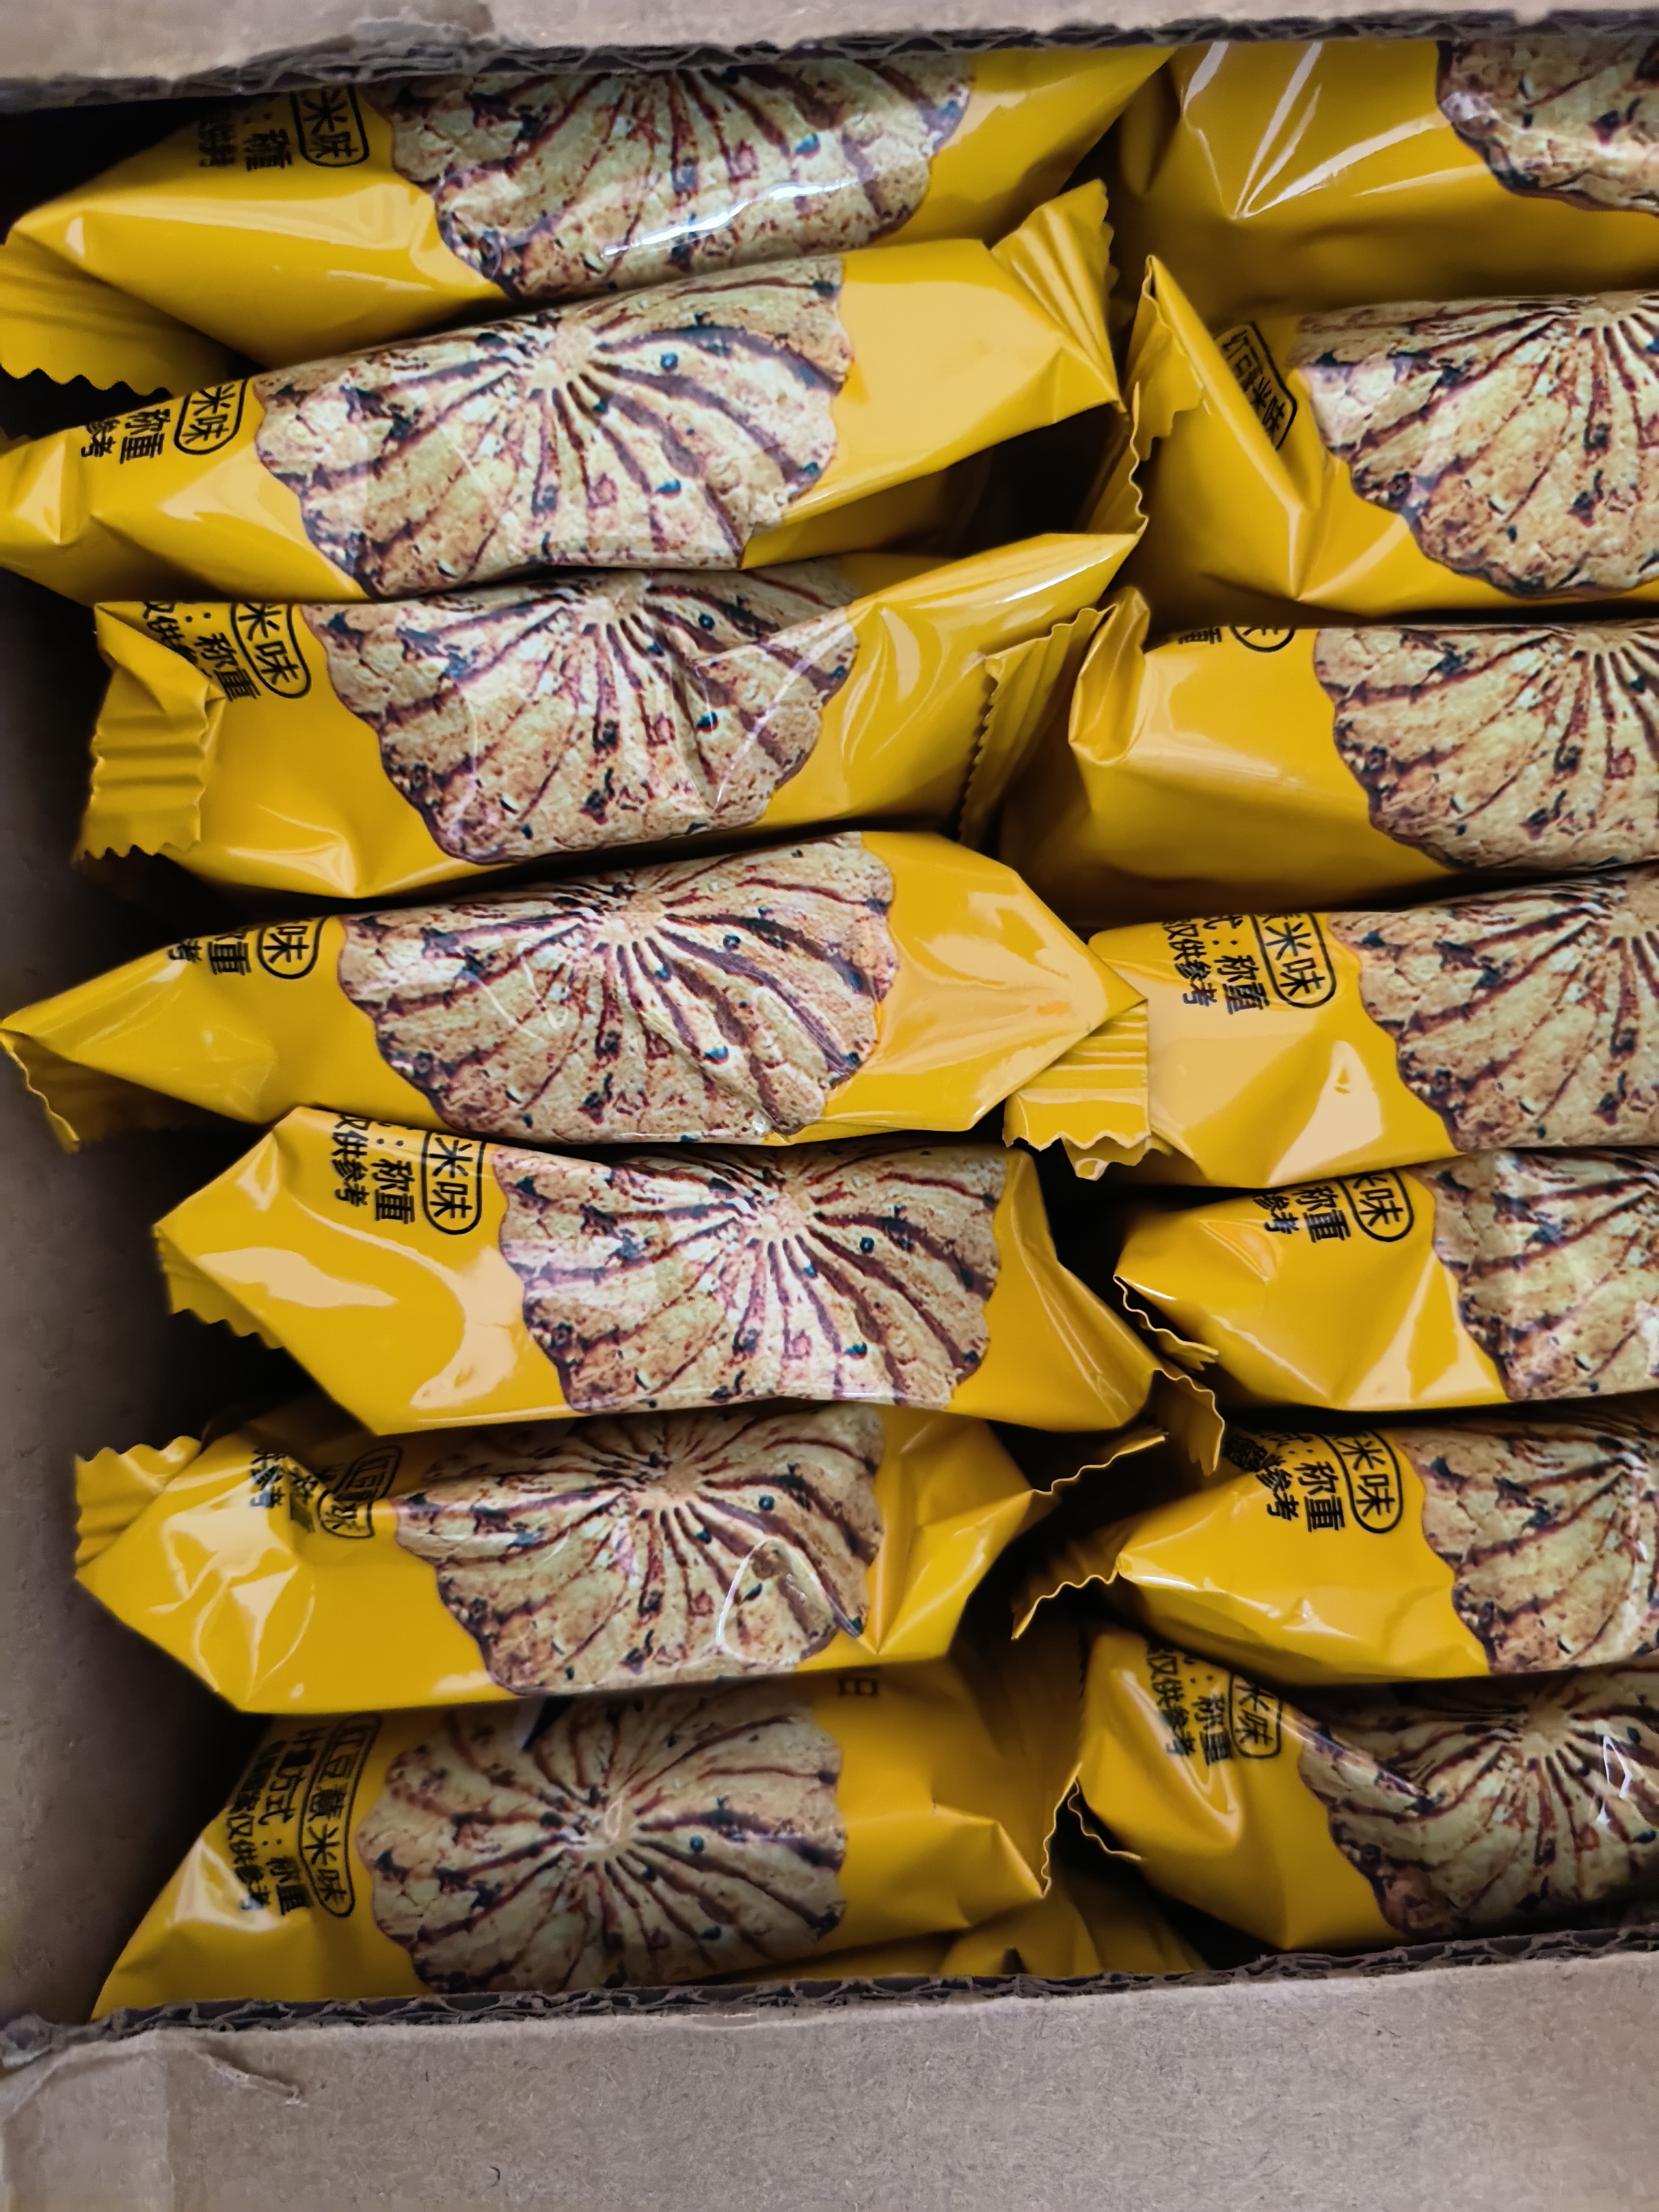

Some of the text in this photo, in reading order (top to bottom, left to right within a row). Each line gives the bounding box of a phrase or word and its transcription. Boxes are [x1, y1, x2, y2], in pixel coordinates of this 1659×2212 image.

[119, 408, 171, 464] 称重
[181, 385, 236, 444] 米味
[1262, 914, 1325, 996] 米味
[428, 1137, 474, 1219] 米味
[1292, 1186, 1351, 1243] 称重
